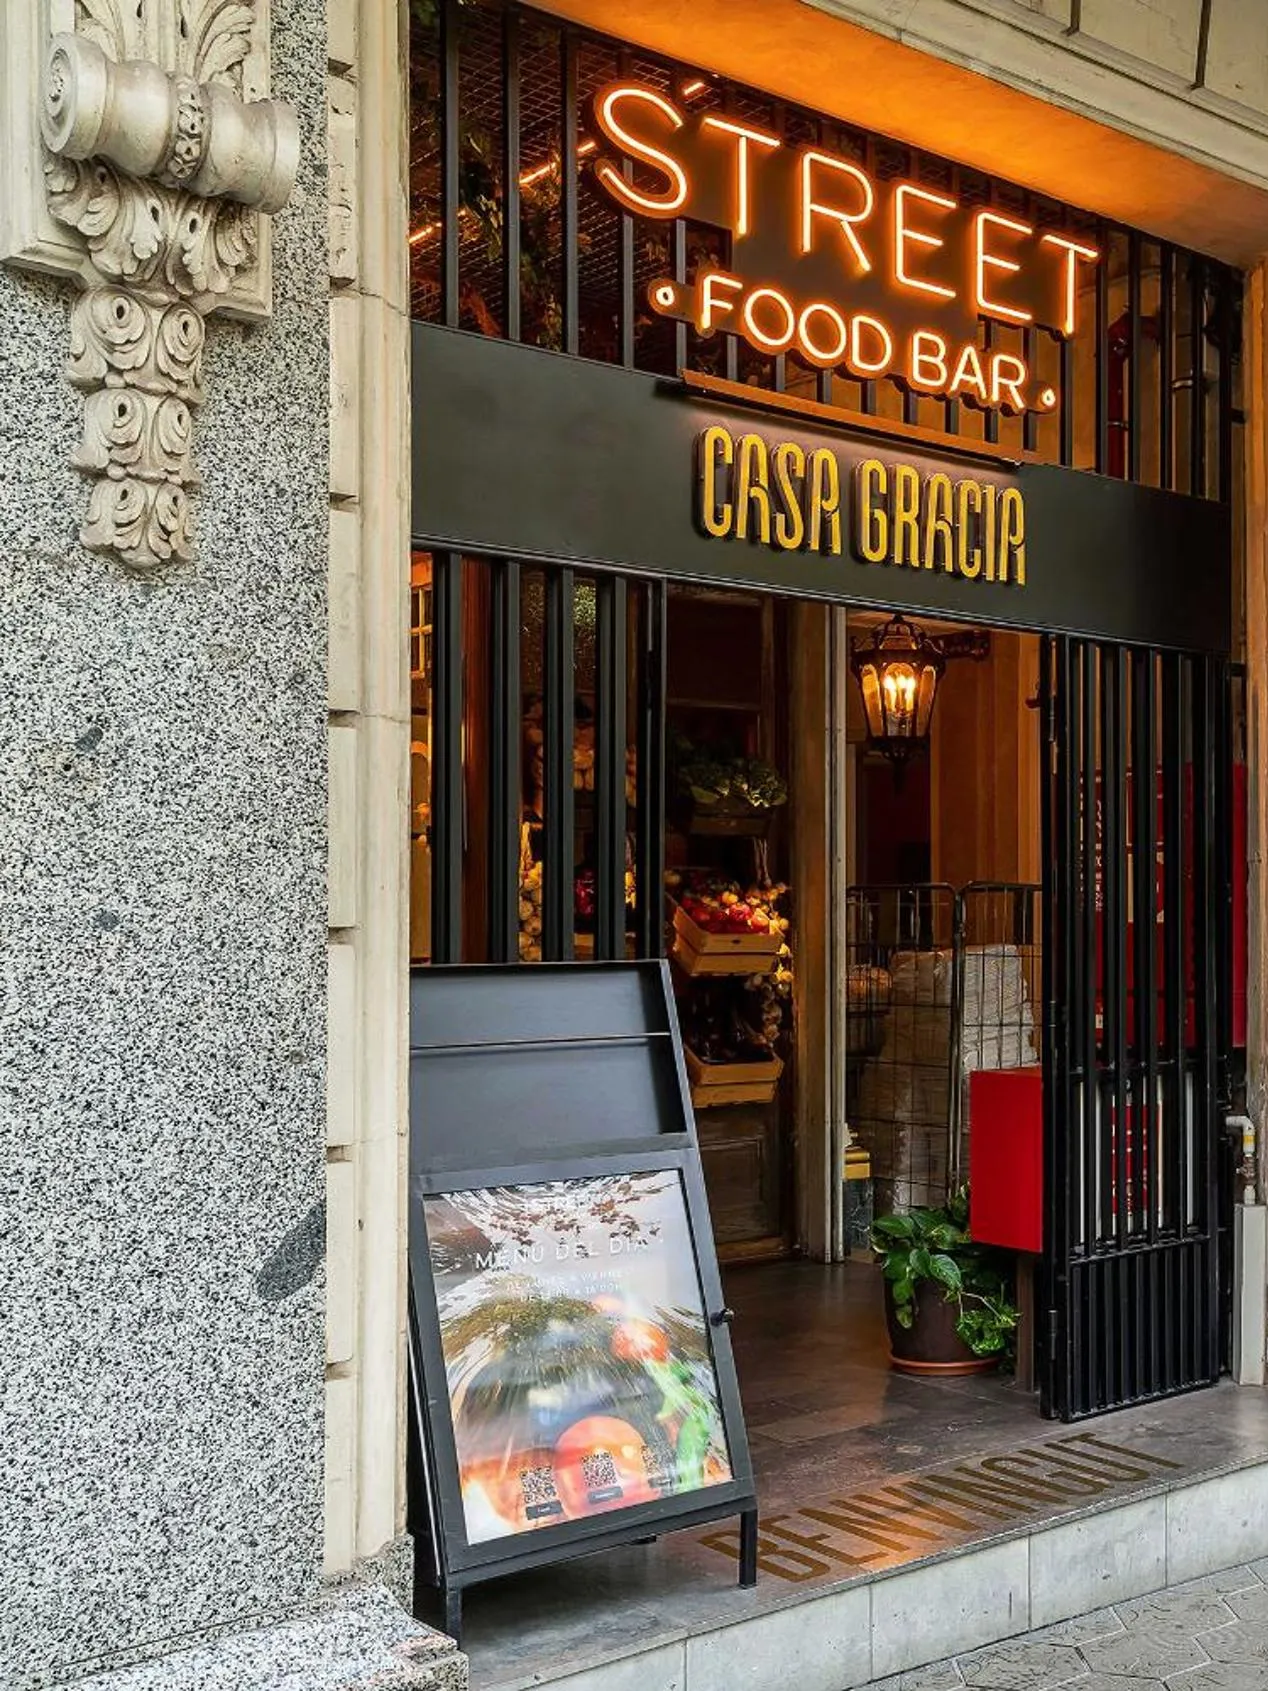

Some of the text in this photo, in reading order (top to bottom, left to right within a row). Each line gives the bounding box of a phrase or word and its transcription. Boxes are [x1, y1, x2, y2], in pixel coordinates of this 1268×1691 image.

[599, 87, 1100, 335] STREET
[701, 274, 1026, 410] FOOD BAR
[699, 425, 1026, 586] CASA GRACIA
[699, 1431, 1184, 1583] BENVINGUT
